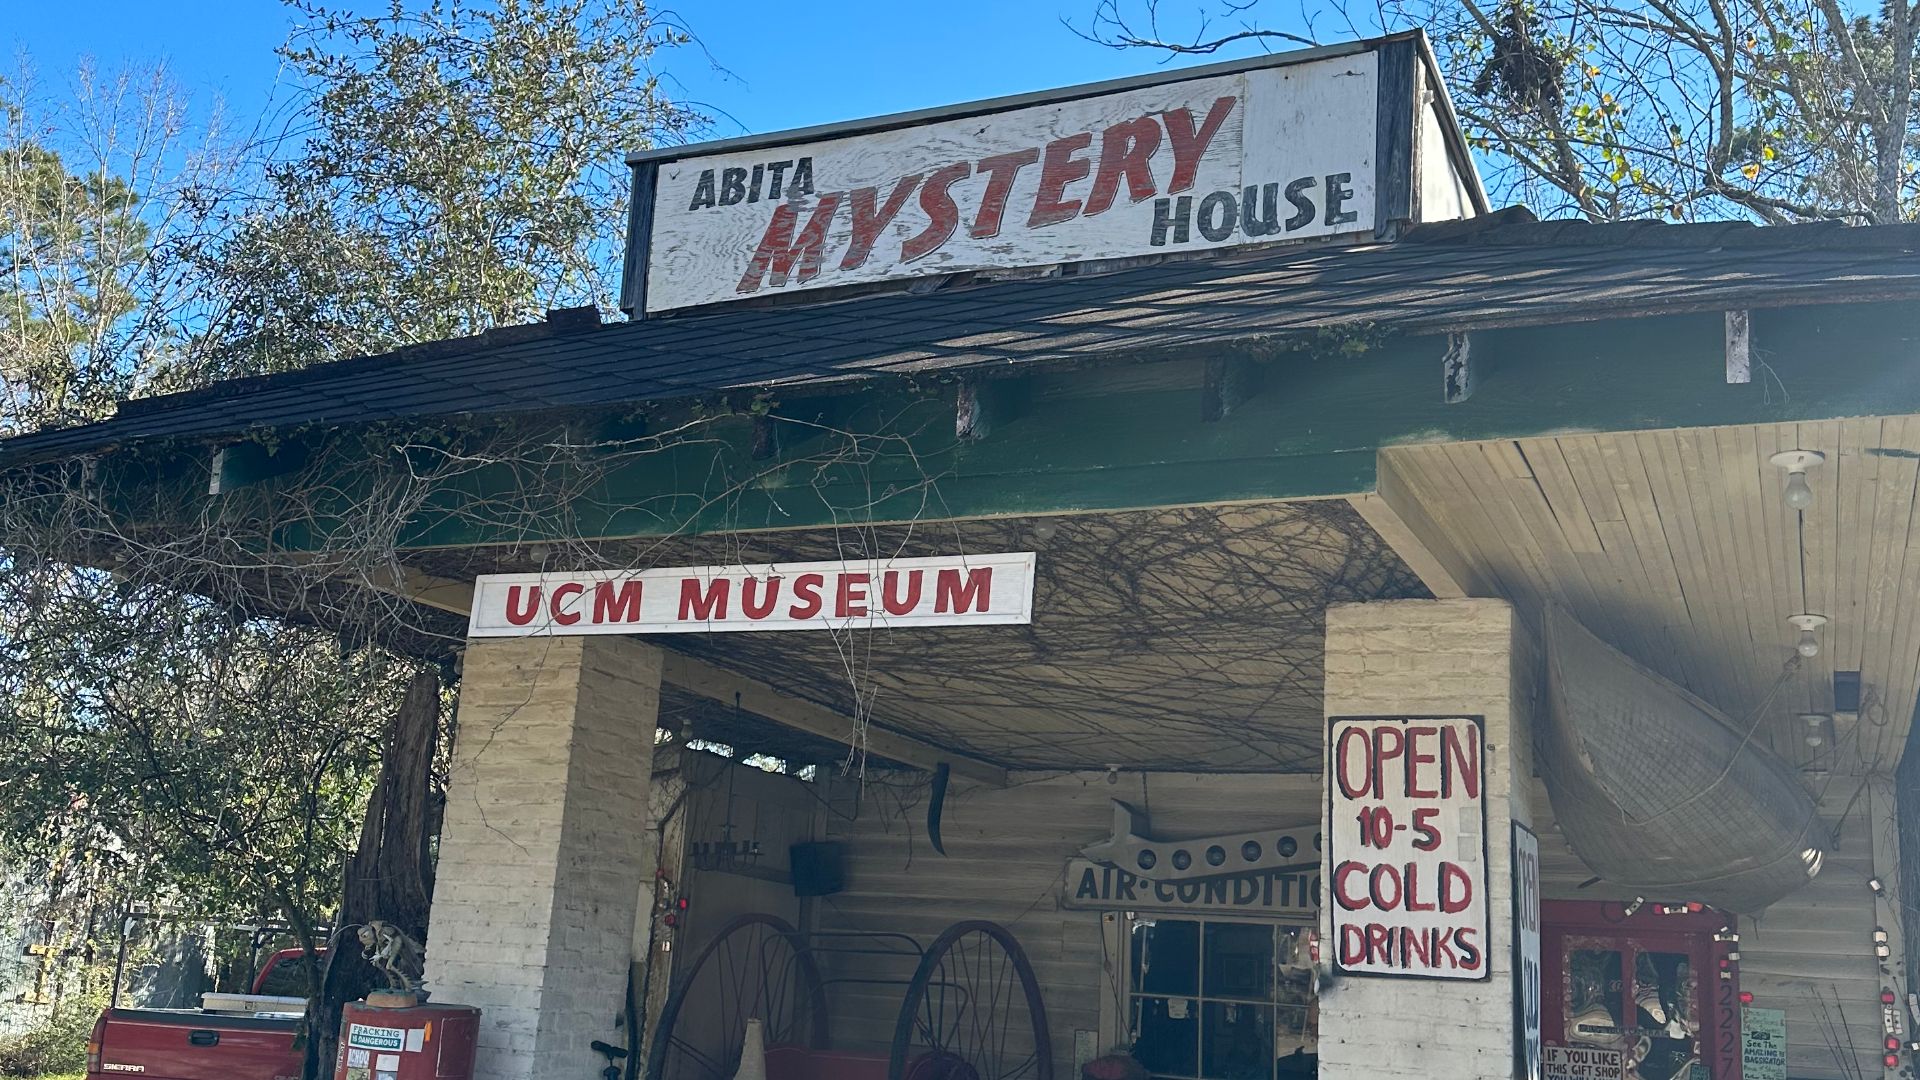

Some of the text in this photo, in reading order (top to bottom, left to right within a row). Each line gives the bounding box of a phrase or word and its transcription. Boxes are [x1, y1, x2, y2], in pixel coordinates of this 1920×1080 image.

[688, 156, 815, 211] ABITA
[735, 96, 1237, 294] MYSTERY
[1149, 171, 1359, 247] HOUSE
[505, 566, 994, 626] UCM MUSEUM
[1336, 724, 1479, 800] OPEN
[1356, 805, 1443, 852] 10-5
[1333, 859, 1473, 914] COLD
[1340, 923, 1482, 971] DRINKS
[353, 1025, 400, 1037] FRACKING
[358, 1035, 398, 1047] DANGEROUS
[1744, 1048, 1777, 1057] AMAZING
[103, 1063, 145, 1073] SIERRA
[1547, 1049, 1619, 1066] IF YOU LIKE
[1547, 1064, 1567, 1074] THIS
[1571, 1065, 1592, 1076] GIFT
[1595, 1066, 1621, 1078] SHOP
